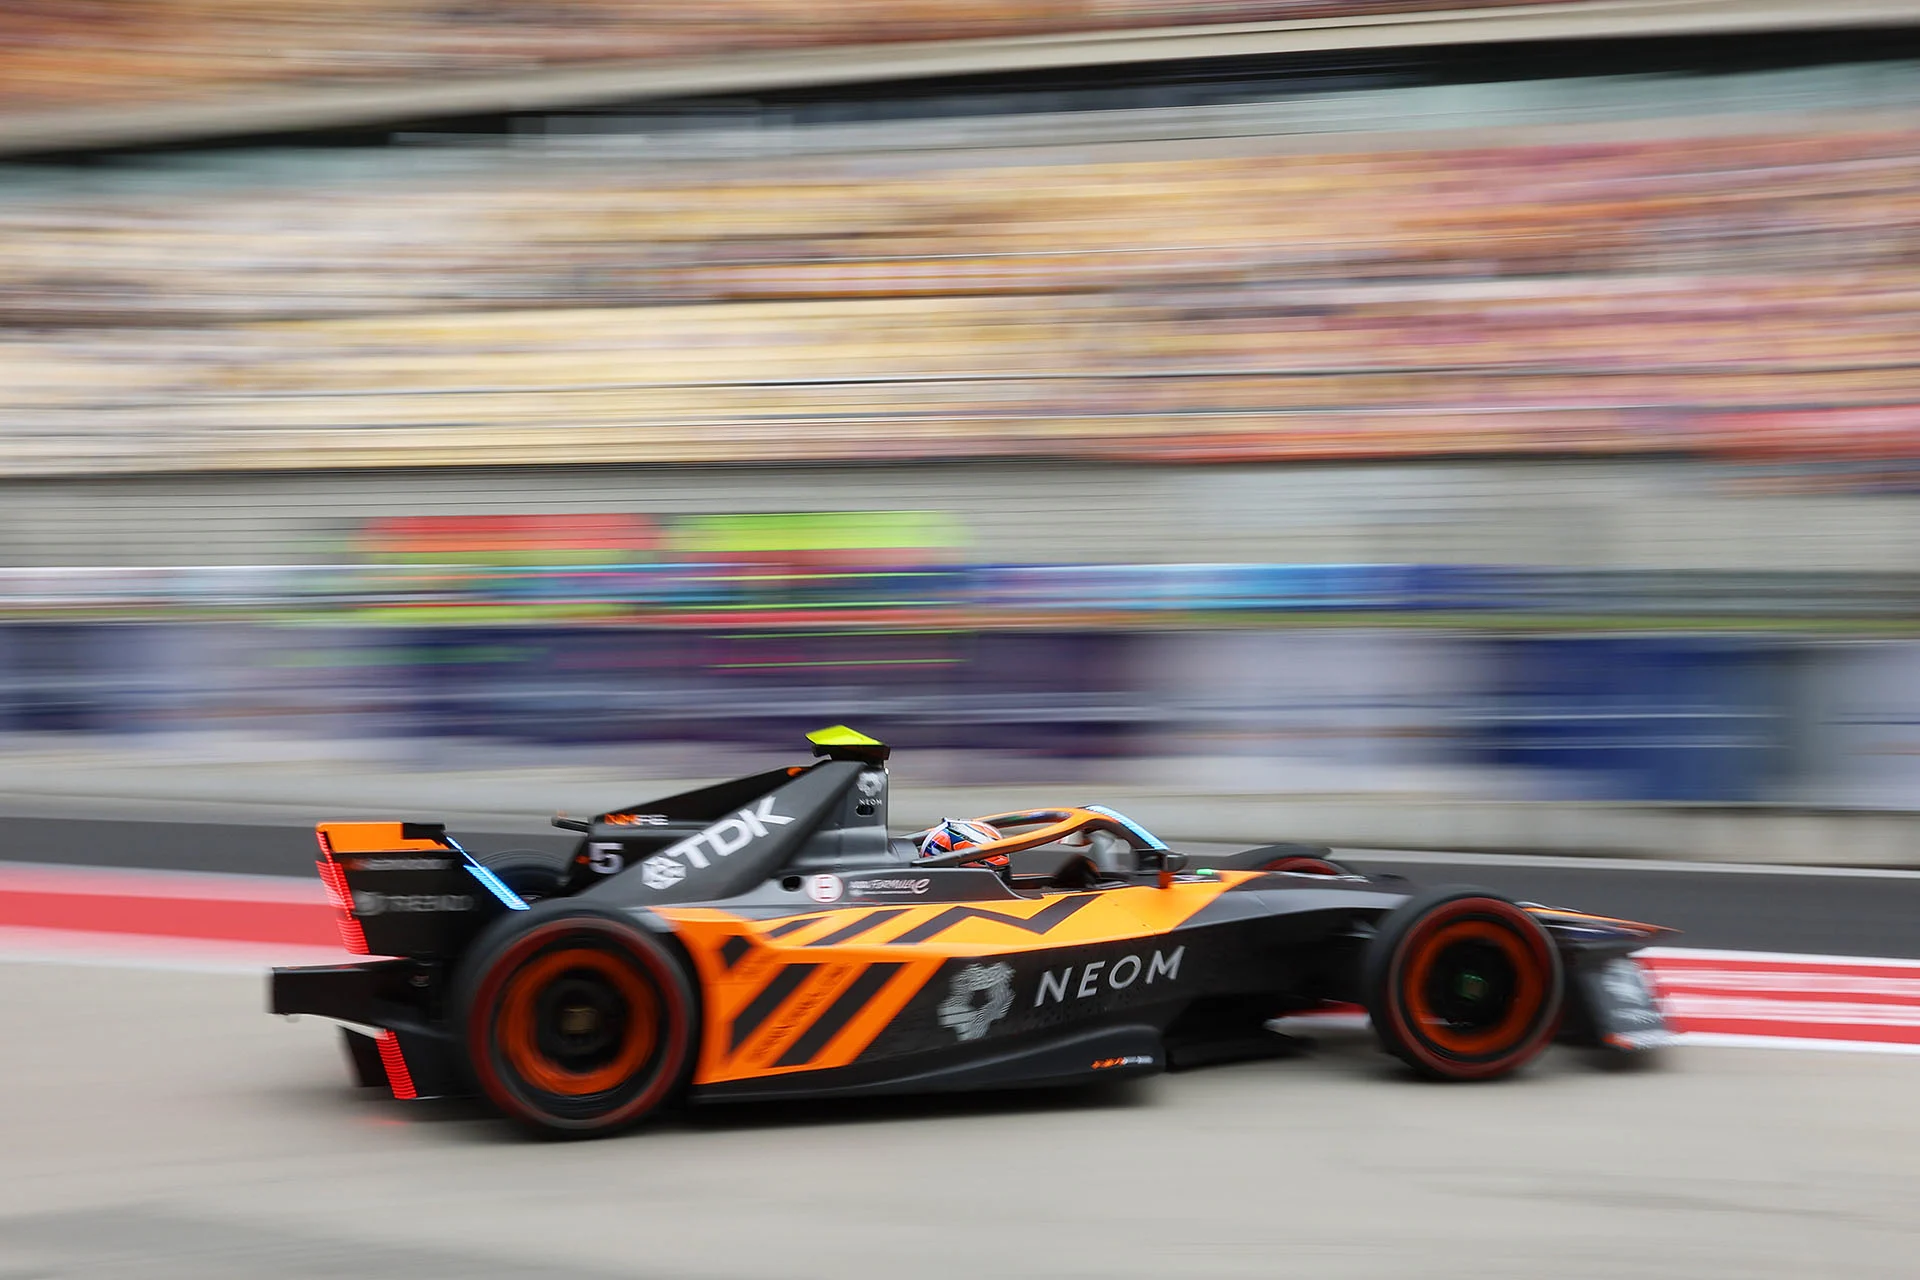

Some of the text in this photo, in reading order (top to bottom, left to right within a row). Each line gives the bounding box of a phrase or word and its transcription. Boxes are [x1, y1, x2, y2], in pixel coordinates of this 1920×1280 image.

[588, 841, 624, 875] 5
[664, 795, 796, 869] TDK
[1034, 945, 1185, 1008] NEOM
